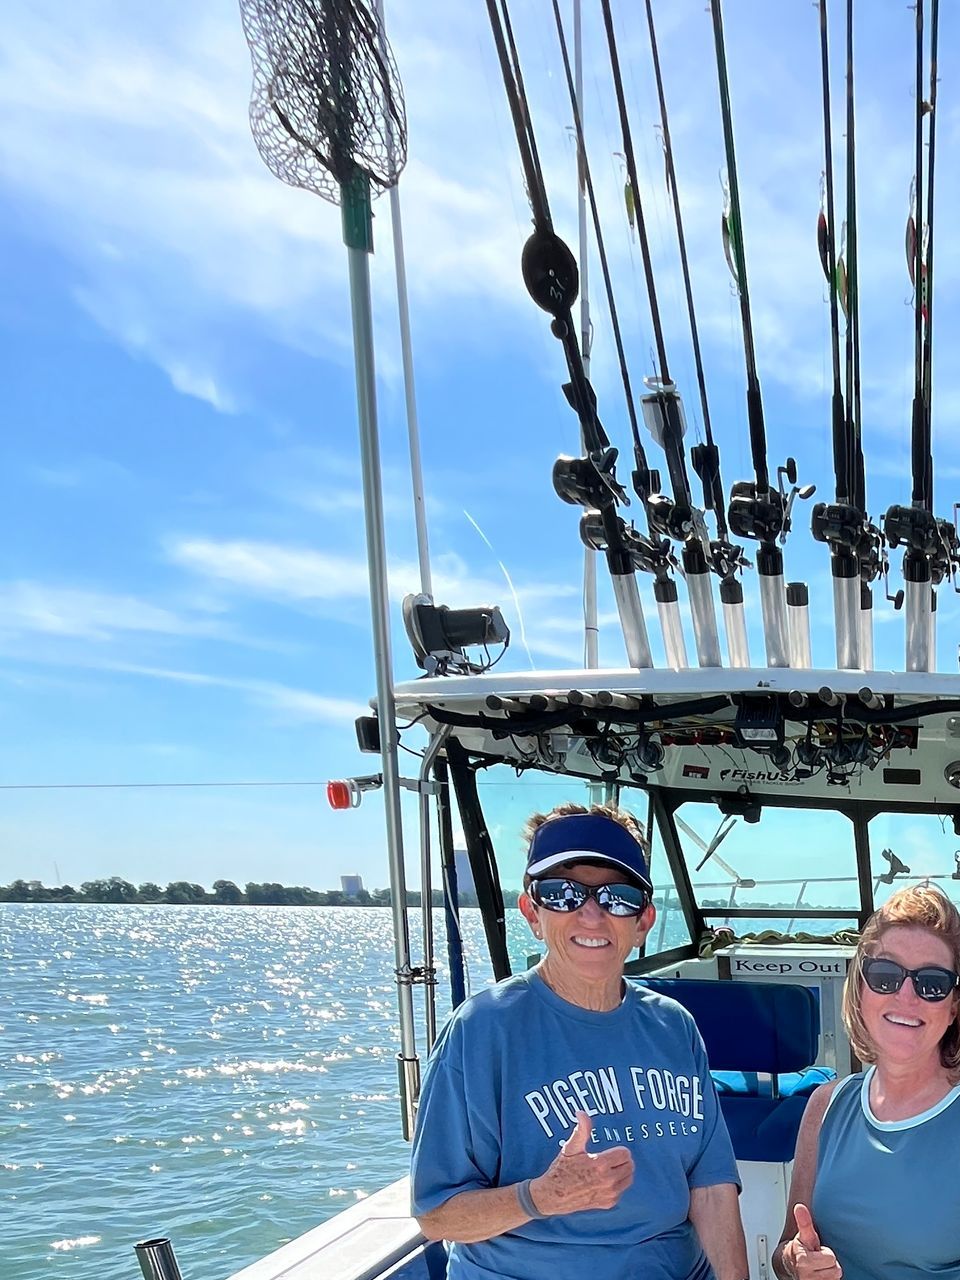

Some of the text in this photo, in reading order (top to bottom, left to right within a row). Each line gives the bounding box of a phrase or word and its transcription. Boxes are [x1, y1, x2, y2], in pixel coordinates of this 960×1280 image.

[731, 769, 801, 782] FishUSA
[735, 960, 841, 974] Keep Out
[524, 1066, 705, 1139] PIGEON FORGE
[591, 1121, 689, 1144] ENNESSEE
